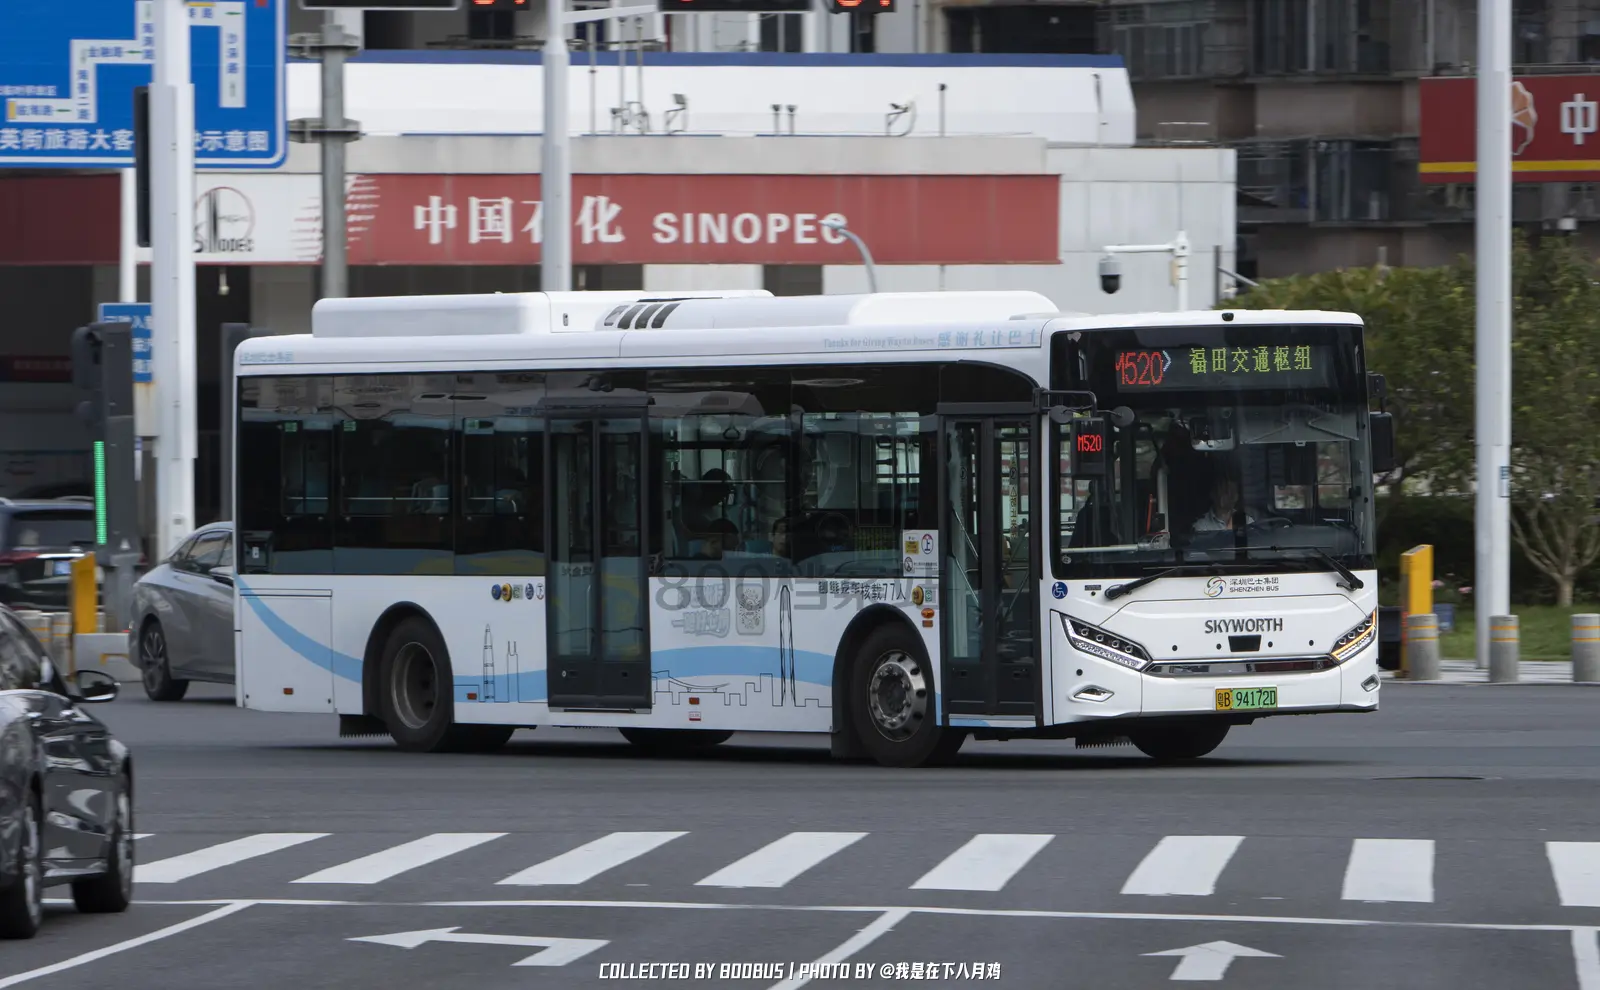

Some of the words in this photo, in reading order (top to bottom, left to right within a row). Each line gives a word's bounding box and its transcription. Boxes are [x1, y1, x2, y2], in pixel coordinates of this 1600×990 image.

[1560, 93, 1598, 145] 中
[652, 212, 848, 244] SINOPEC
[1189, 345, 1313, 374] 福田交通枢纽
[1077, 434, 1103, 452] M520
[1229, 576, 1279, 586] 深圳巴士集团
[1204, 617, 1283, 634] SKYWORTH
